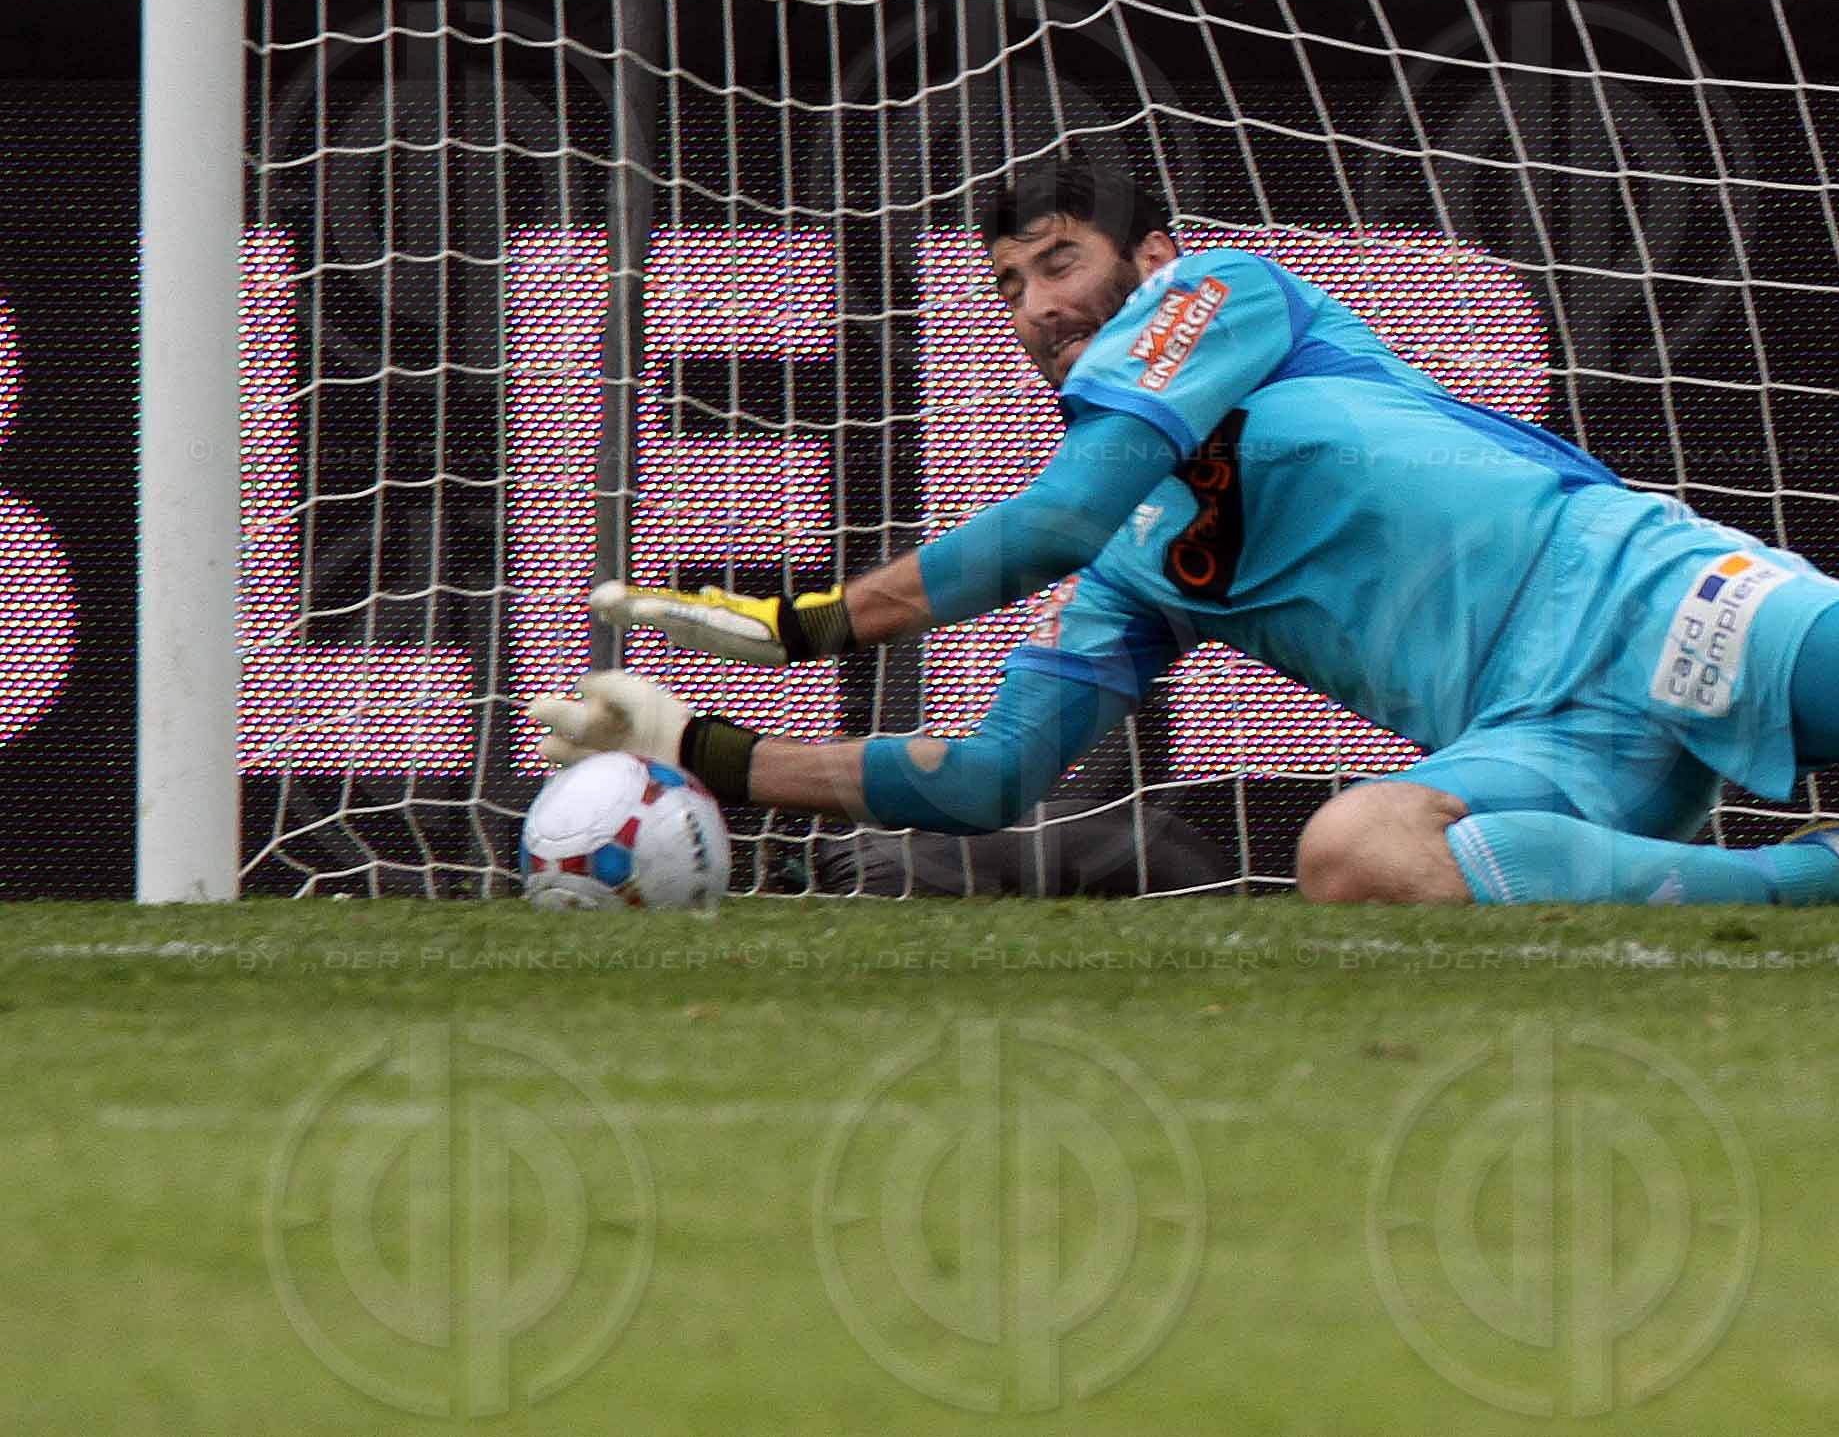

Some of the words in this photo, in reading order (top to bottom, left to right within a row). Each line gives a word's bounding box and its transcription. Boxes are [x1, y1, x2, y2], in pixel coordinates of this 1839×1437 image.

[1132, 292, 1188, 359] WIEN
[1143, 281, 1225, 391] ENERGIE
[1668, 616, 1706, 697] card
[1696, 570, 1778, 707] complete
